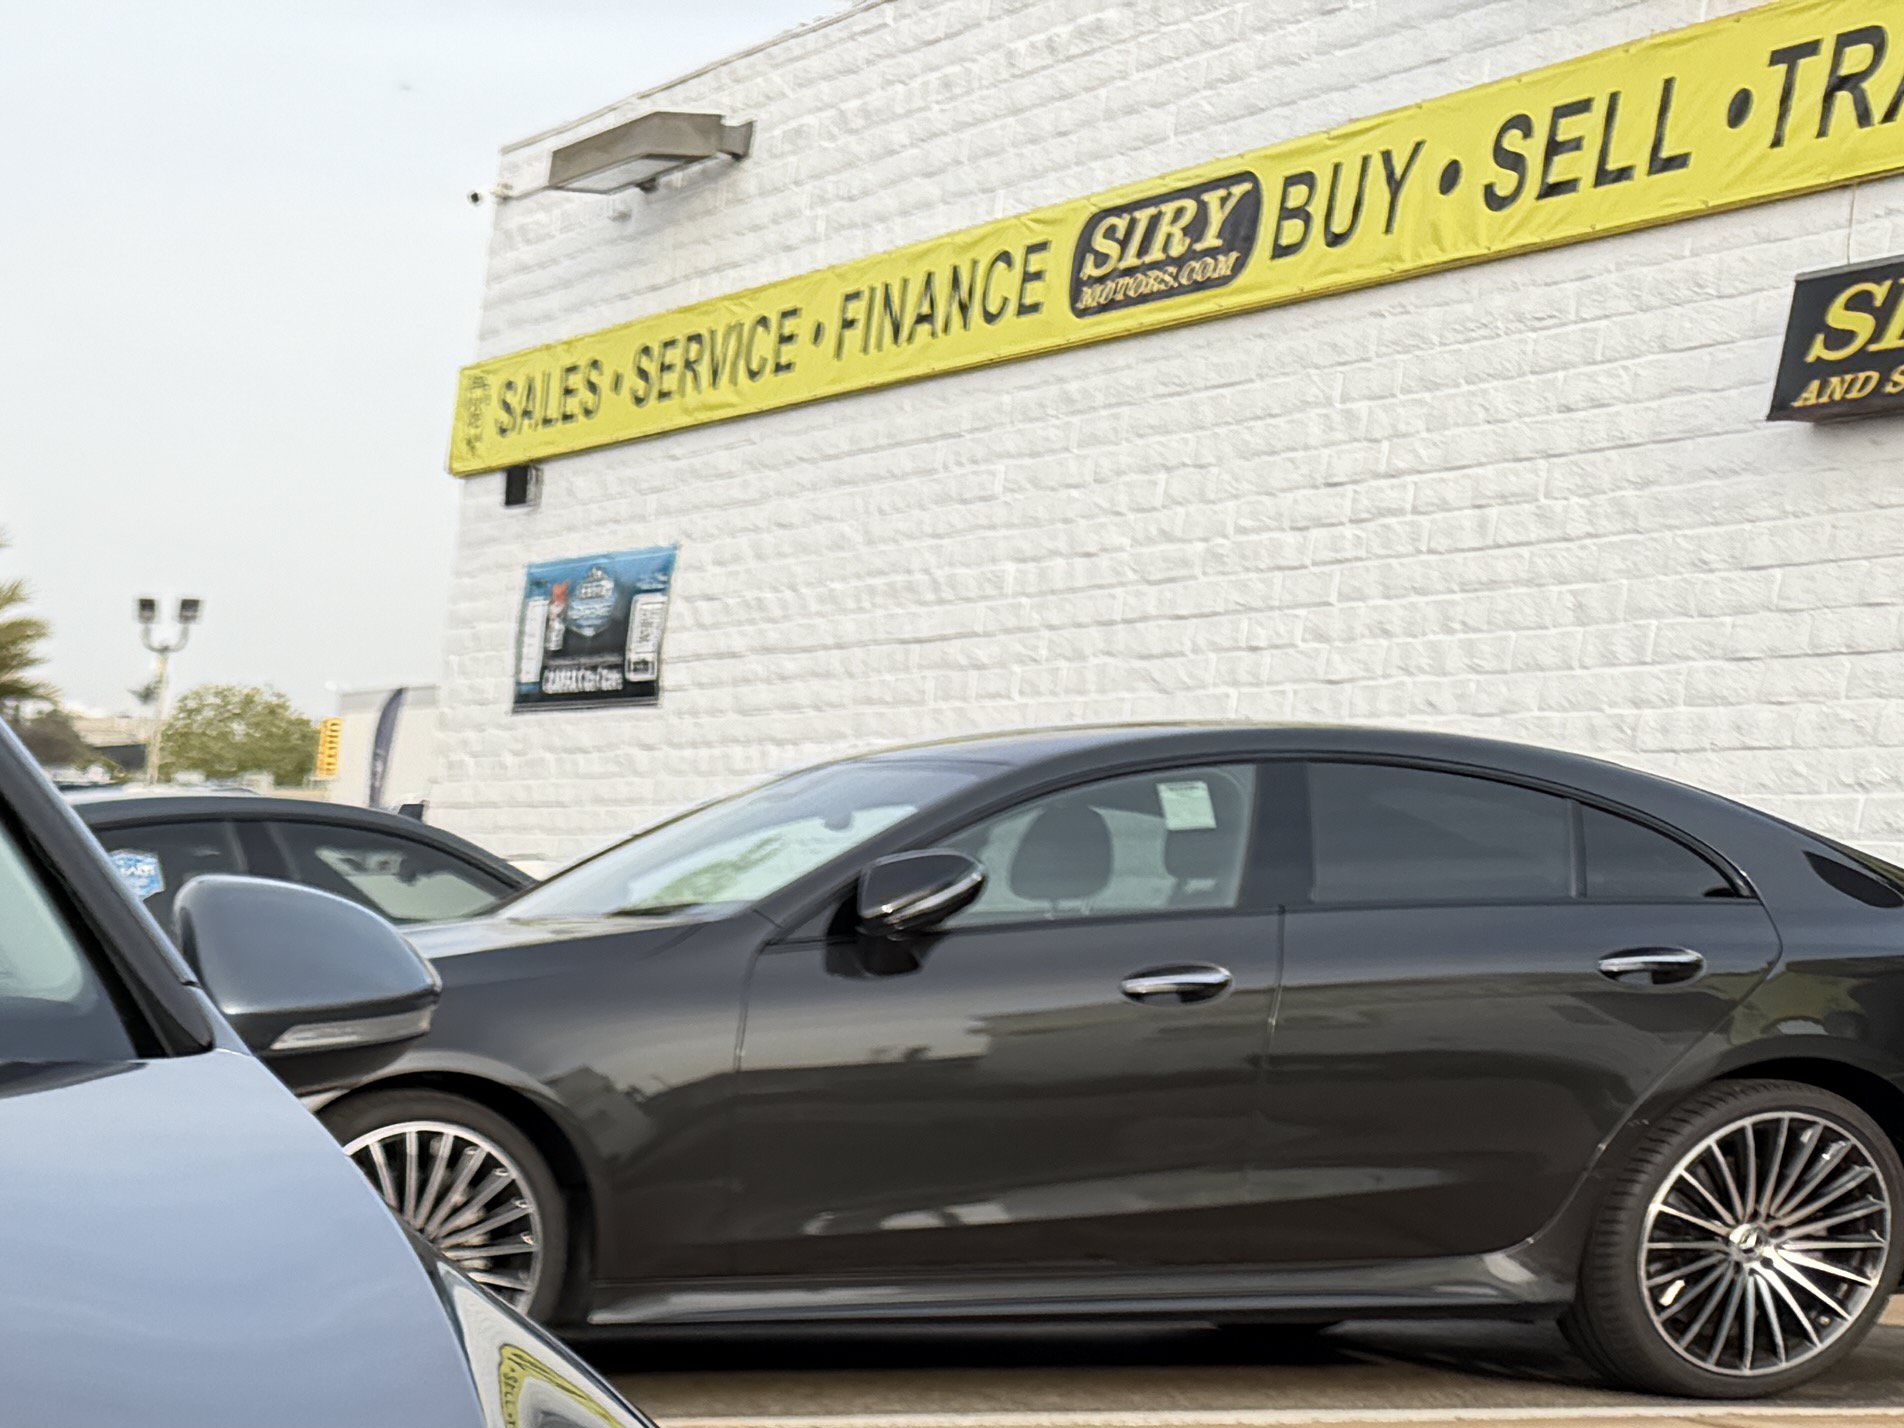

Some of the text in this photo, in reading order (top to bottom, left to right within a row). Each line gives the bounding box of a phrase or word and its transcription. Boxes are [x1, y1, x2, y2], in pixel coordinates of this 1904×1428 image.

[1270, 139, 1427, 261] BUY
[1483, 76, 1692, 212] SELL
[1076, 251, 1241, 309] MOTORS.COM
[1080, 182, 1253, 281] SIRY
[495, 359, 603, 438] SALES
[631, 307, 801, 408] SERVICE
[833, 239, 1050, 362] FINANCE
[1790, 370, 1881, 407] AND
